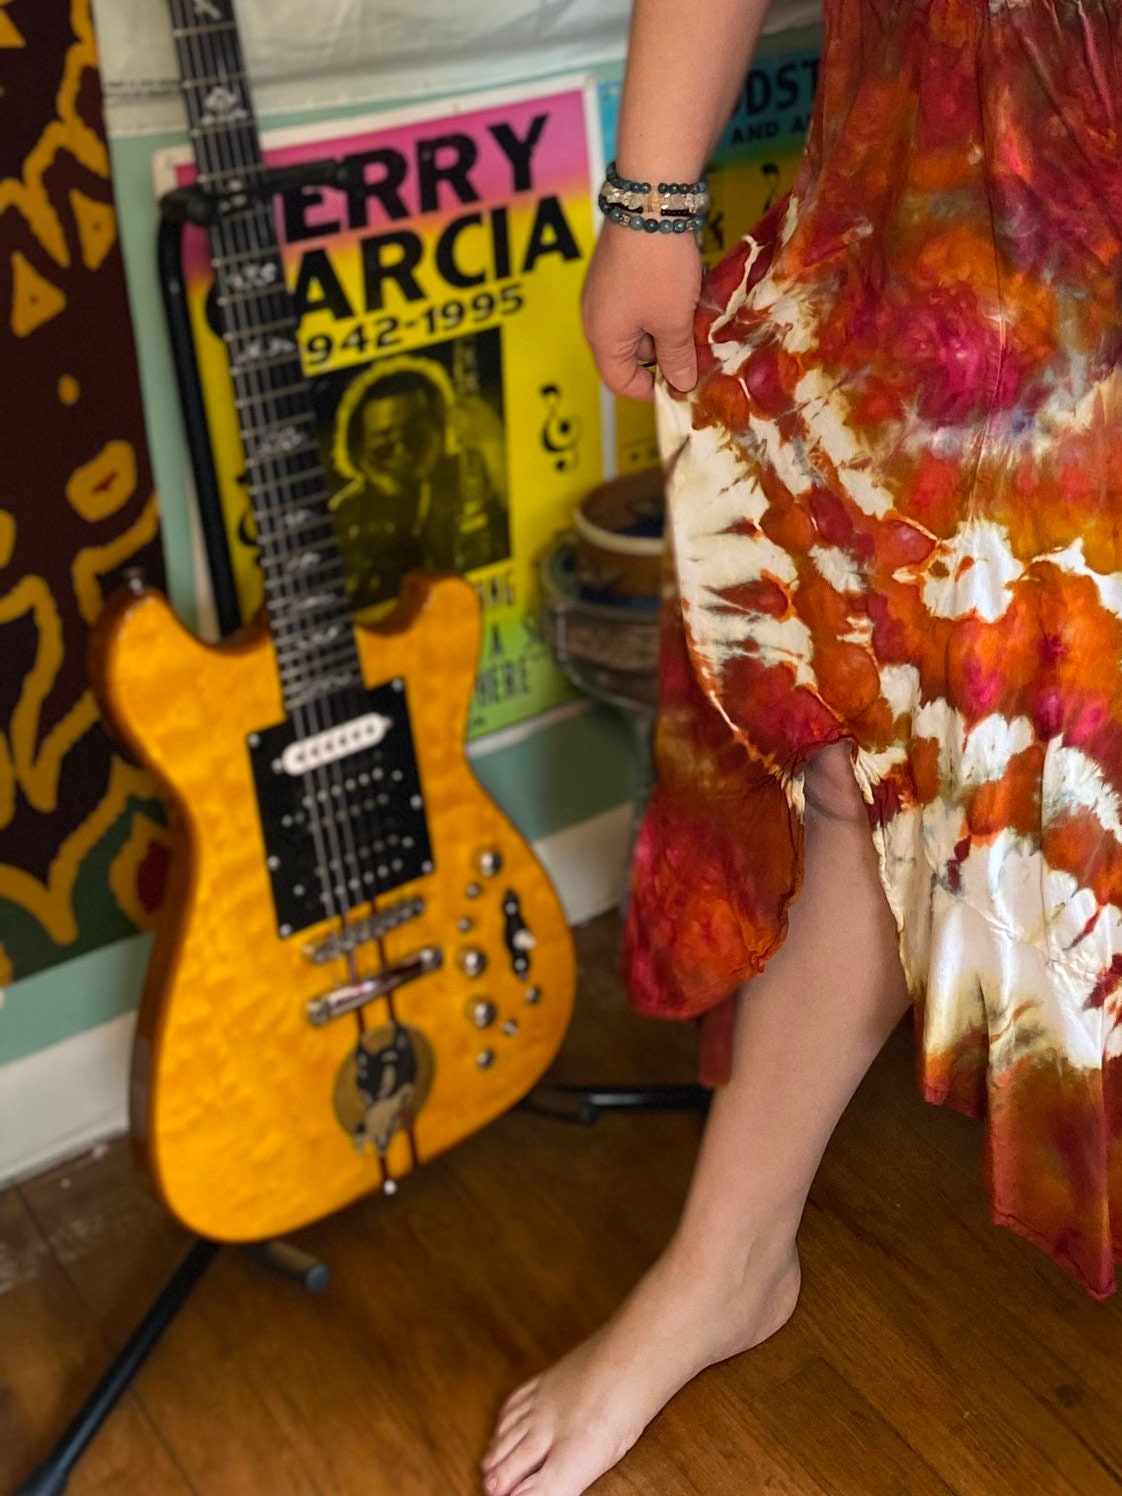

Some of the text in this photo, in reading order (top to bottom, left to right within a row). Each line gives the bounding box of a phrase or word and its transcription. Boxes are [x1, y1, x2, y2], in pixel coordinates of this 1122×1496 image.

[281, 113, 551, 245] ERRY
[291, 195, 583, 324] ARCIA
[305, 283, 525, 365] 942-1995
